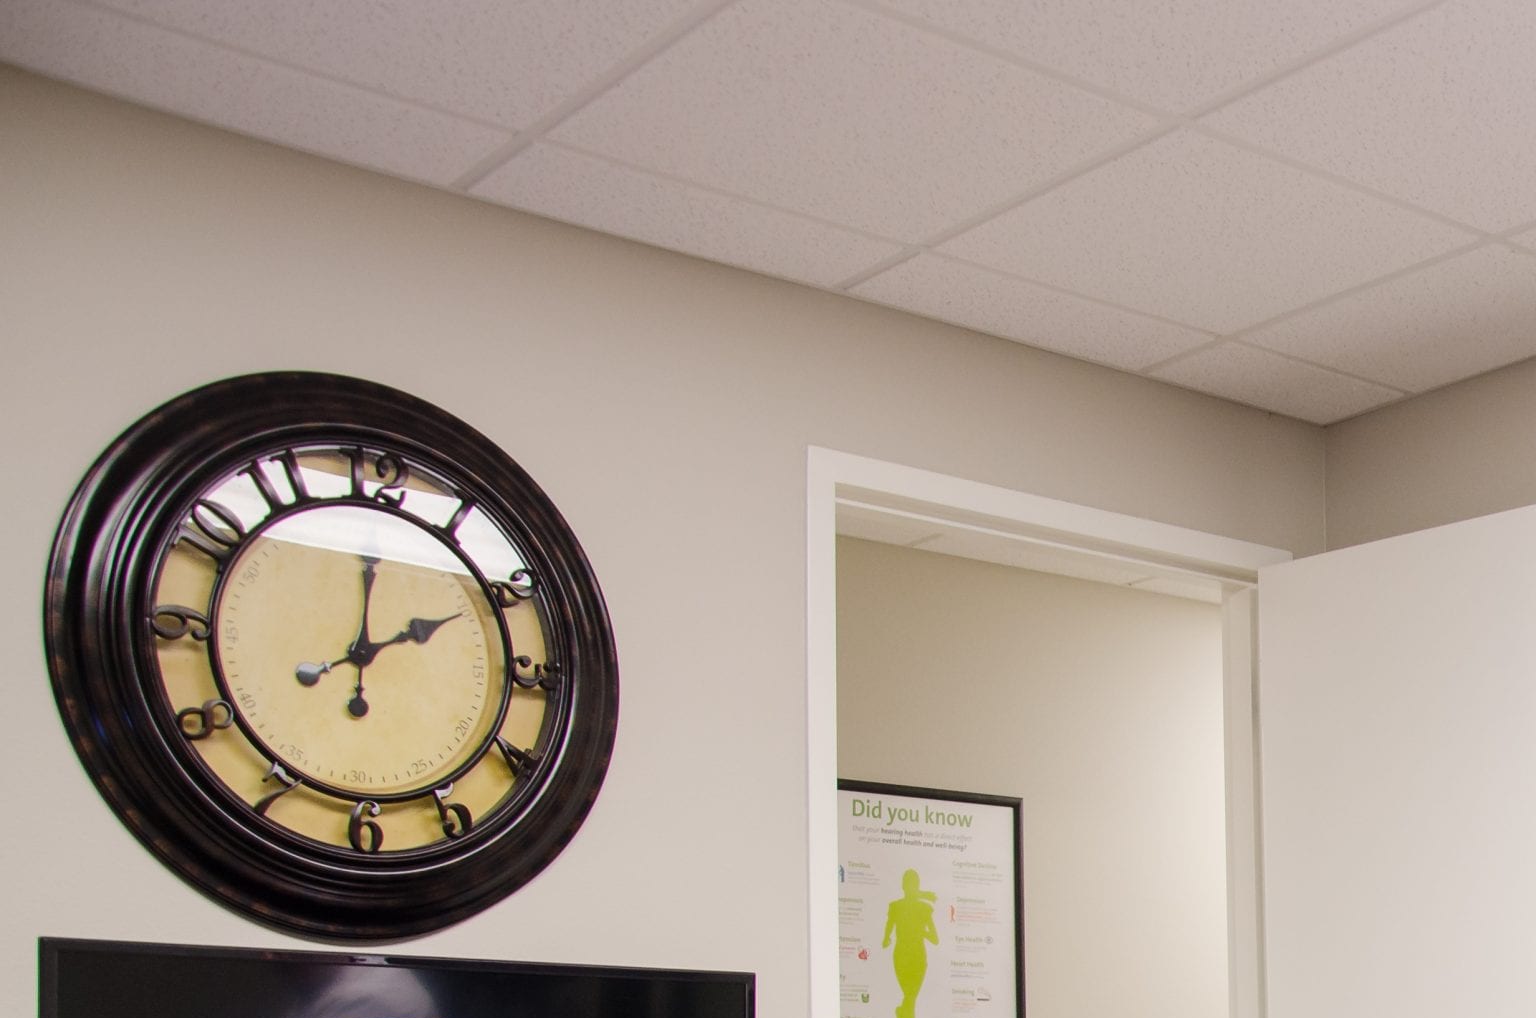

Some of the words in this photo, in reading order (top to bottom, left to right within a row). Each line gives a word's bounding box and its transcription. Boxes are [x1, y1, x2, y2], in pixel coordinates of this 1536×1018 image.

[239, 448, 315, 520] 11
[339, 445, 409, 506] 12
[171, 497, 248, 574] 10
[430, 488, 478, 548] 1
[493, 567, 540, 617] 2
[147, 602, 212, 643] 9
[512, 654, 562, 692] 3
[174, 698, 235, 741] 8
[455, 719, 471, 738] 20
[351, 770, 367, 784] 30
[411, 759, 428, 775] 25
[494, 735, 542, 780] 4
[252, 760, 303, 818] 7
[431, 781, 474, 840] 5
[347, 800, 384, 856] 6
[852, 799, 882, 819] Did
[886, 806, 920, 826] you
[924, 806, 973, 828] know
[880, 827, 904, 837] hearing
[904, 829, 923, 837] health
[903, 838, 922, 846] health
